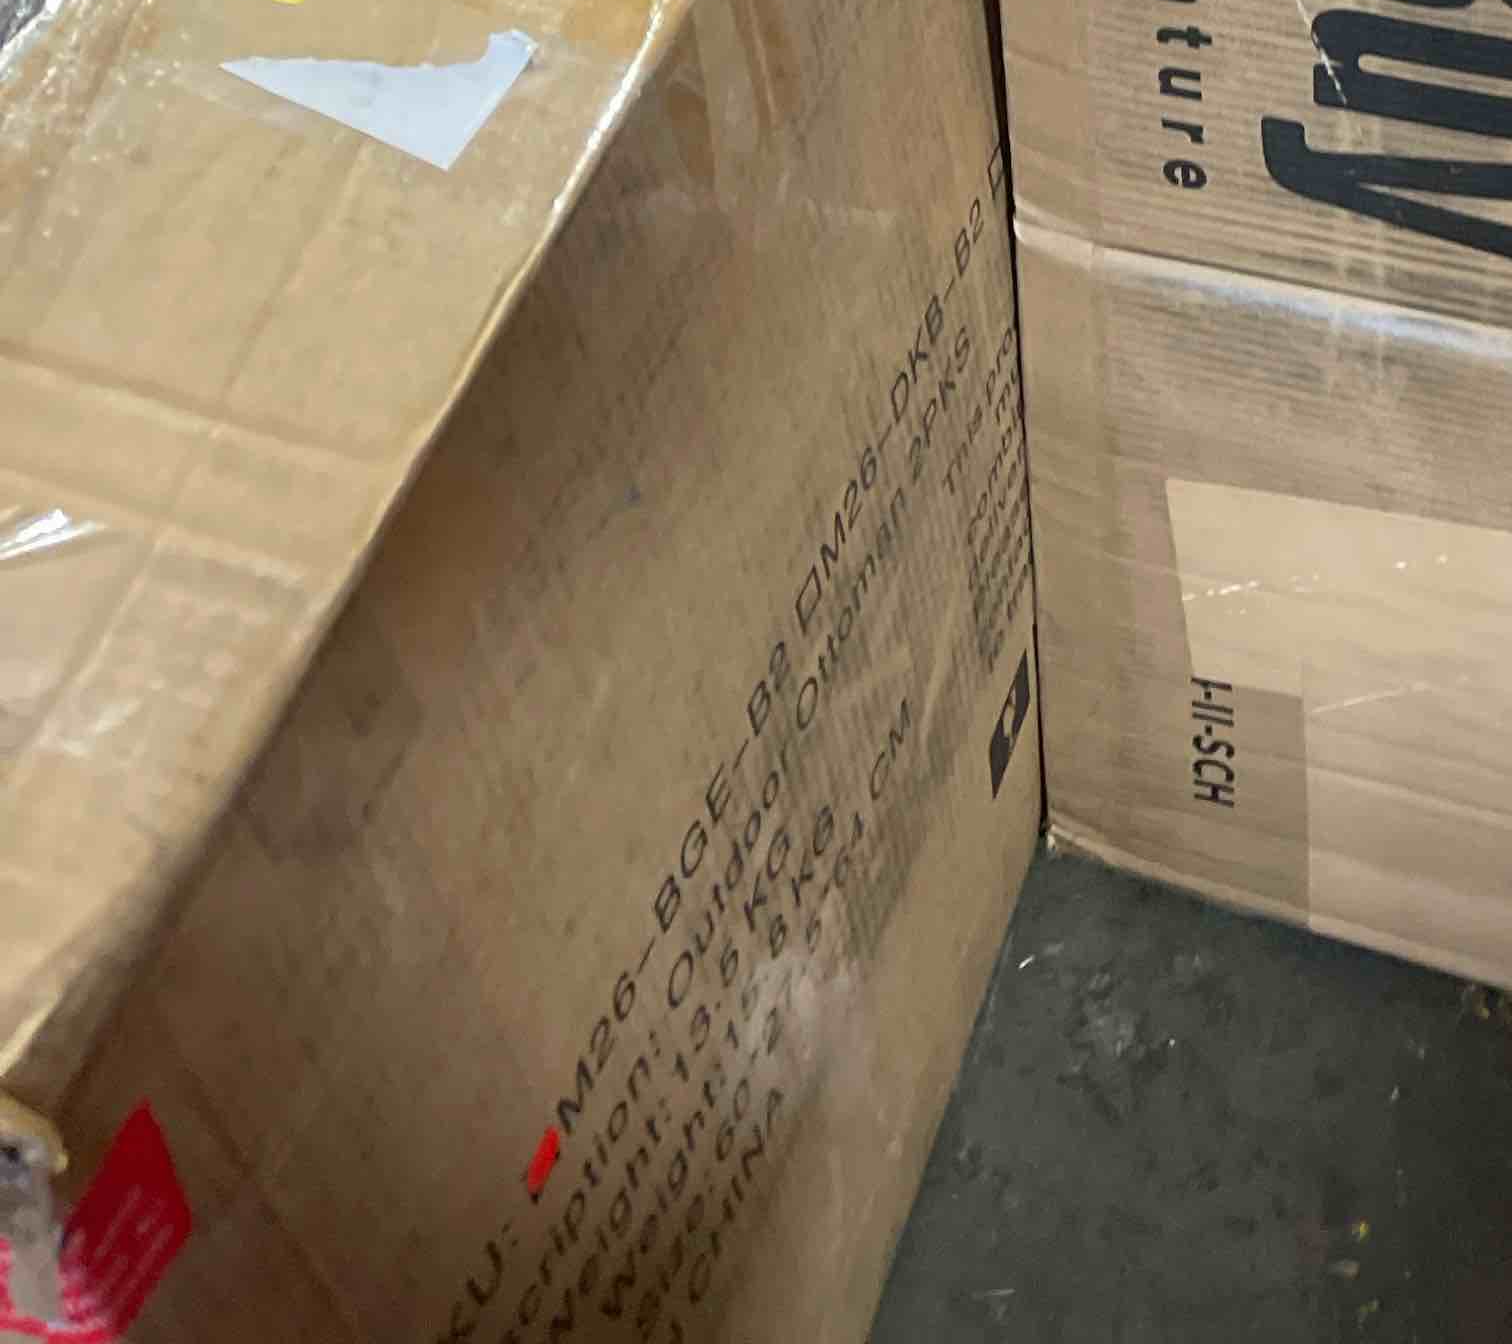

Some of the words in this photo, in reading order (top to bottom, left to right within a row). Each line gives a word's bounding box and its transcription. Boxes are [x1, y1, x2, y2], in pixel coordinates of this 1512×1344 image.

[556, 640, 790, 1136] M26-BGE-B2
[818, 198, 985, 580] M26-DKB-B2
[667, 740, 791, 1010] Outdoor
[796, 488, 907, 730] Ottoman
[908, 324, 970, 486] 2PKS
[870, 697, 912, 802] CM
[602, 1060, 724, 1318] Weight:
[790, 803, 835, 910] KG
[744, 824, 791, 933] KG
[688, 1087, 783, 1304] CHINA
